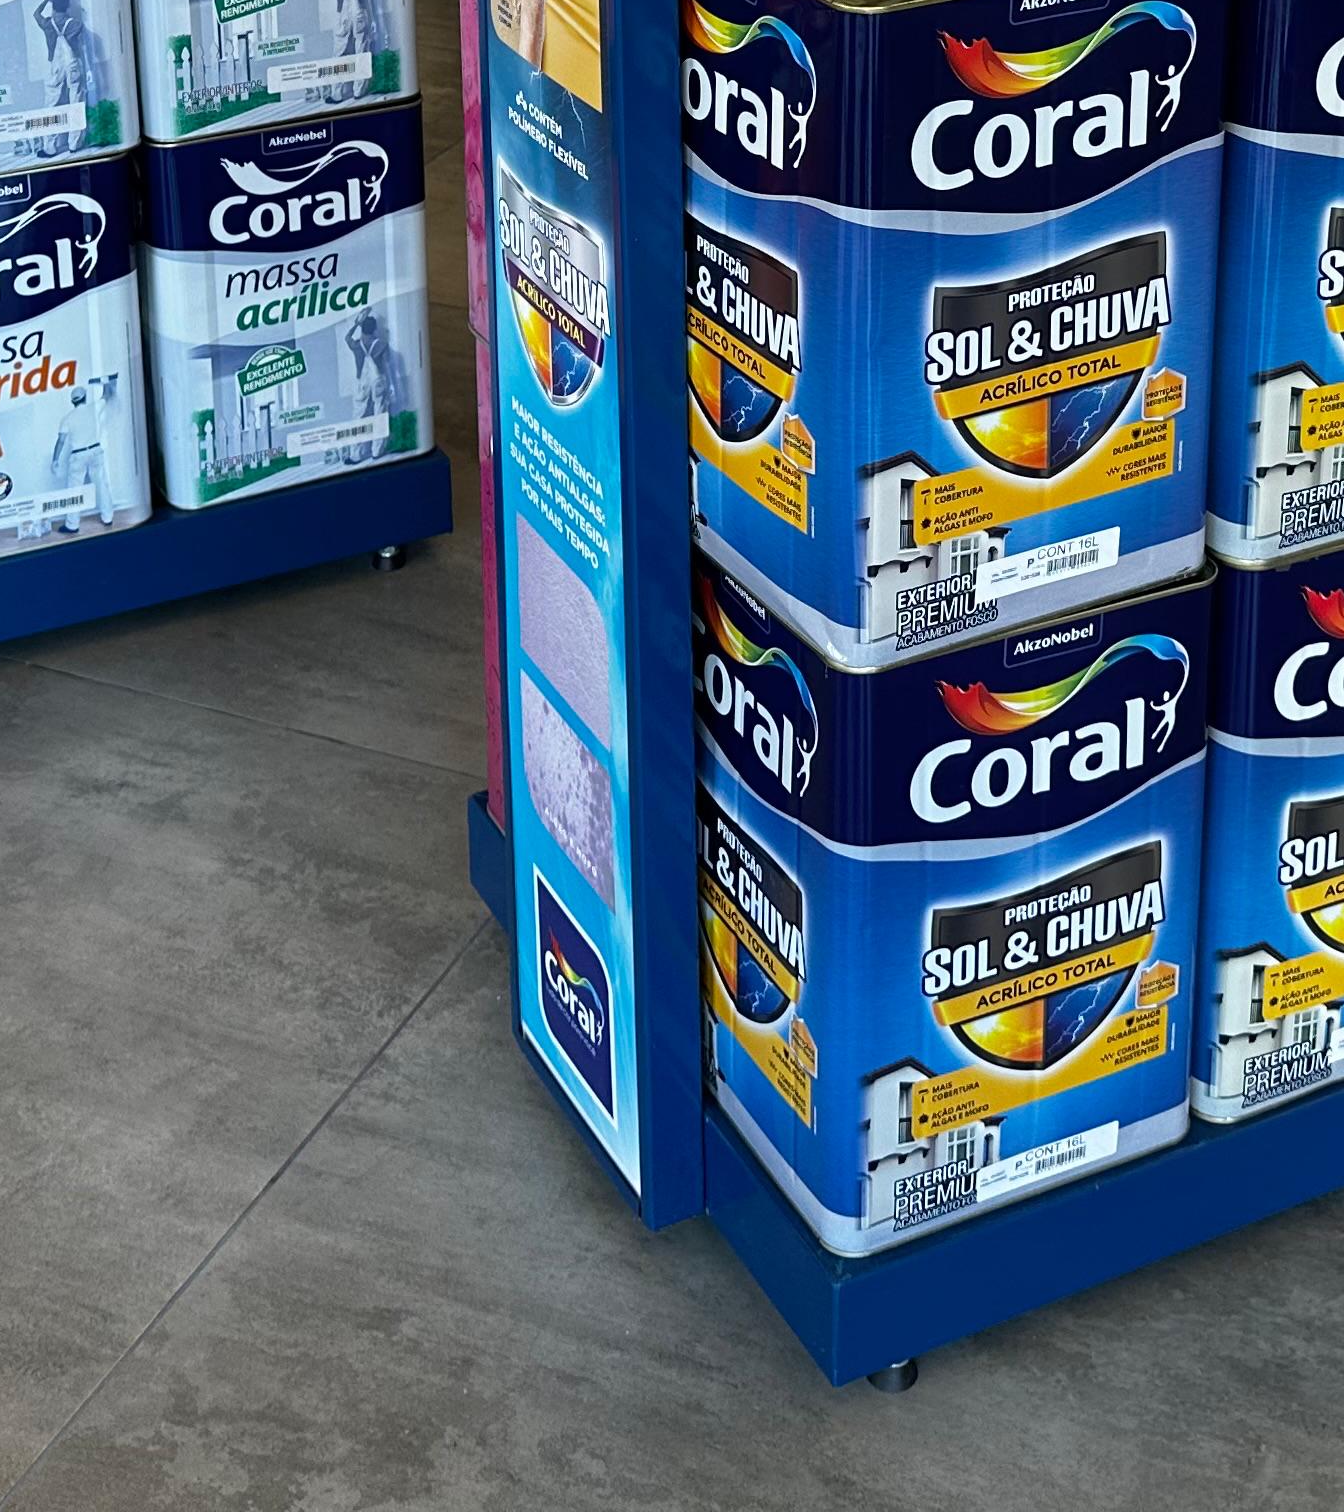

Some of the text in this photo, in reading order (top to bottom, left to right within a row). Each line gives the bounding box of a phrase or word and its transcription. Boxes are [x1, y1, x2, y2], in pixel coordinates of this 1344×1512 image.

[529, 102, 563, 139] CONTÉM
[548, 138, 589, 181] FLEXÍVEL
[910, 69, 1150, 192] Coral
[499, 197, 611, 337] SOL & CHUVA
[529, 205, 570, 256] PROTEÇÃO
[517, 274, 586, 349] ACRÍLICO TOTAL
[925, 276, 1171, 386] SOL & CHUVA
[1008, 273, 1096, 314] PROTEÇÃO
[979, 354, 1122, 407] ACRÍLICO TOTAL
[512, 395, 604, 500] MAIOR RESISTÊNCIA
[514, 422, 520, 440] E
[522, 432, 546, 467] AÇÃO
[510, 442, 610, 558] SUA CASA PROTEGIDA
[521, 477, 599, 569] POR MAIS TEMPO
[909, 698, 1146, 825] Coral
[545, 950, 595, 1044] Coral
